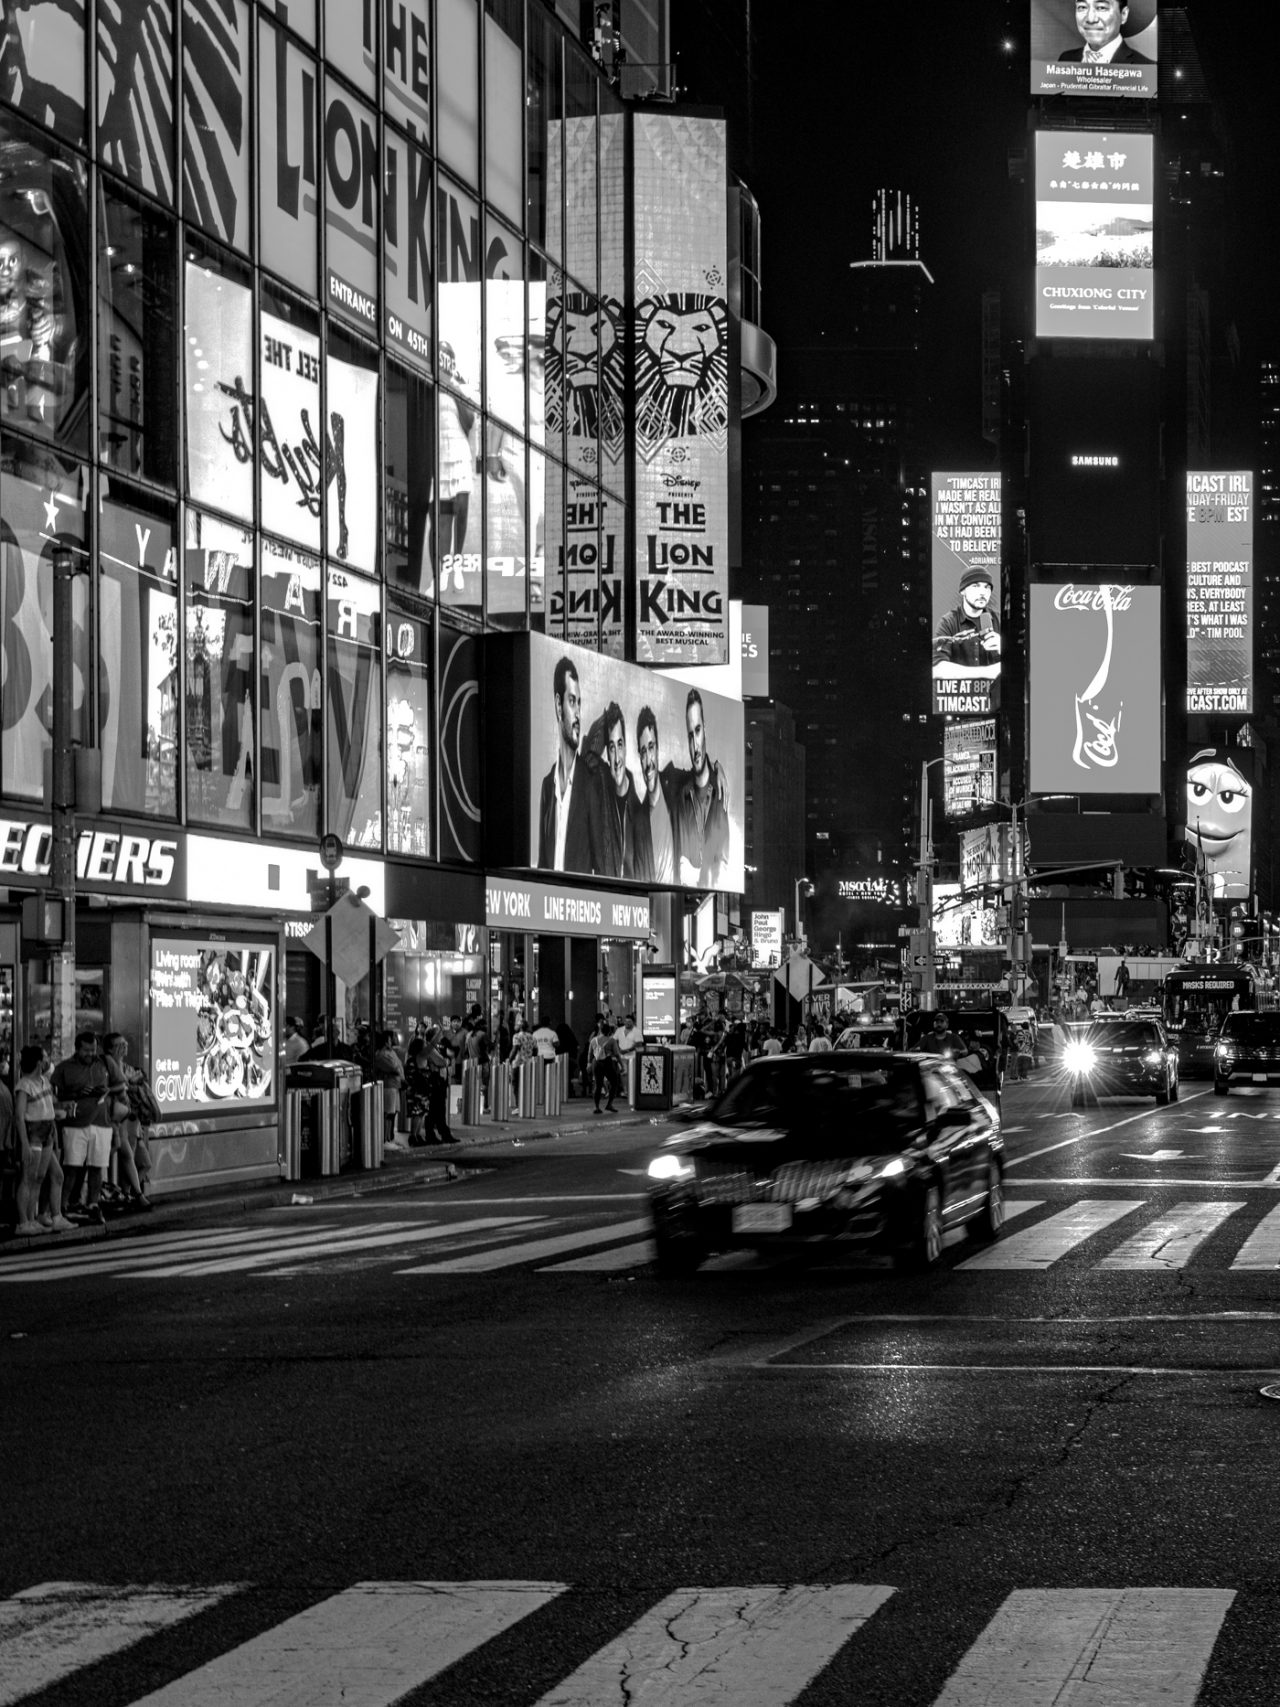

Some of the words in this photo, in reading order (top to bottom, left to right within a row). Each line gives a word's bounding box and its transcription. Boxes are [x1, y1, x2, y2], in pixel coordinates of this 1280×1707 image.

[1046, 65, 1092, 76] Masaharu
[1095, 66, 1142, 79] Hasegawa
[1042, 286, 1113, 299] CHUXIONG
[1117, 289, 1147, 300] CITY
[330, 275, 377, 322] ENTRANCE
[388, 315, 403, 340] ON
[407, 328, 429, 358] 45TH
[1072, 456, 1118, 466] SAMSUNG
[1229, 475, 1250, 492] IRL
[938, 490, 962, 501] MADE
[964, 490, 977, 501] ME
[656, 501, 706, 526] THE
[935, 502, 939, 513] I
[941, 502, 973, 513] WASN'T
[975, 502, 986, 513] AS
[935, 514, 944, 526] IN
[946, 514, 960, 526] MY
[1227, 507, 1249, 522] EST
[937, 526, 948, 538] AS
[955, 526, 973, 538] HAD
[975, 526, 996, 538] BEEN
[950, 540, 960, 552] TO
[647, 535, 713, 575] LION
[1191, 562, 1211, 573] BEST
[1213, 562, 1249, 573] PODCAST
[1188, 574, 1222, 586] CULTURE
[1224, 575, 1241, 585] AND
[1200, 588, 1247, 599] EVERYBODY
[640, 580, 722, 624] KING
[1208, 601, 1219, 612] AT
[1220, 601, 1245, 612] LEAST
[1201, 614, 1223, 625] WHAT
[1230, 614, 1248, 625] WAS
[640, 629, 655, 638] THE
[656, 630, 725, 639] AWARD-WINNING
[1207, 628, 1222, 638] TIM
[1223, 628, 1244, 638] POOL
[655, 637, 673, 645] BEST
[675, 638, 709, 646] MUSICAL
[937, 680, 958, 694] LIVE
[959, 680, 972, 693] AT
[937, 696, 991, 712] TIMCAST.
[0, 820, 178, 886] ECERS
[502, 891, 531, 918] YORK
[543, 895, 564, 921] LINE
[565, 898, 602, 925] FRIENDS
[612, 903, 631, 927] NEW
[155, 950, 179, 971] Living
[1182, 981, 1204, 990] MASKS
[1204, 981, 1235, 989] REQUIRED
